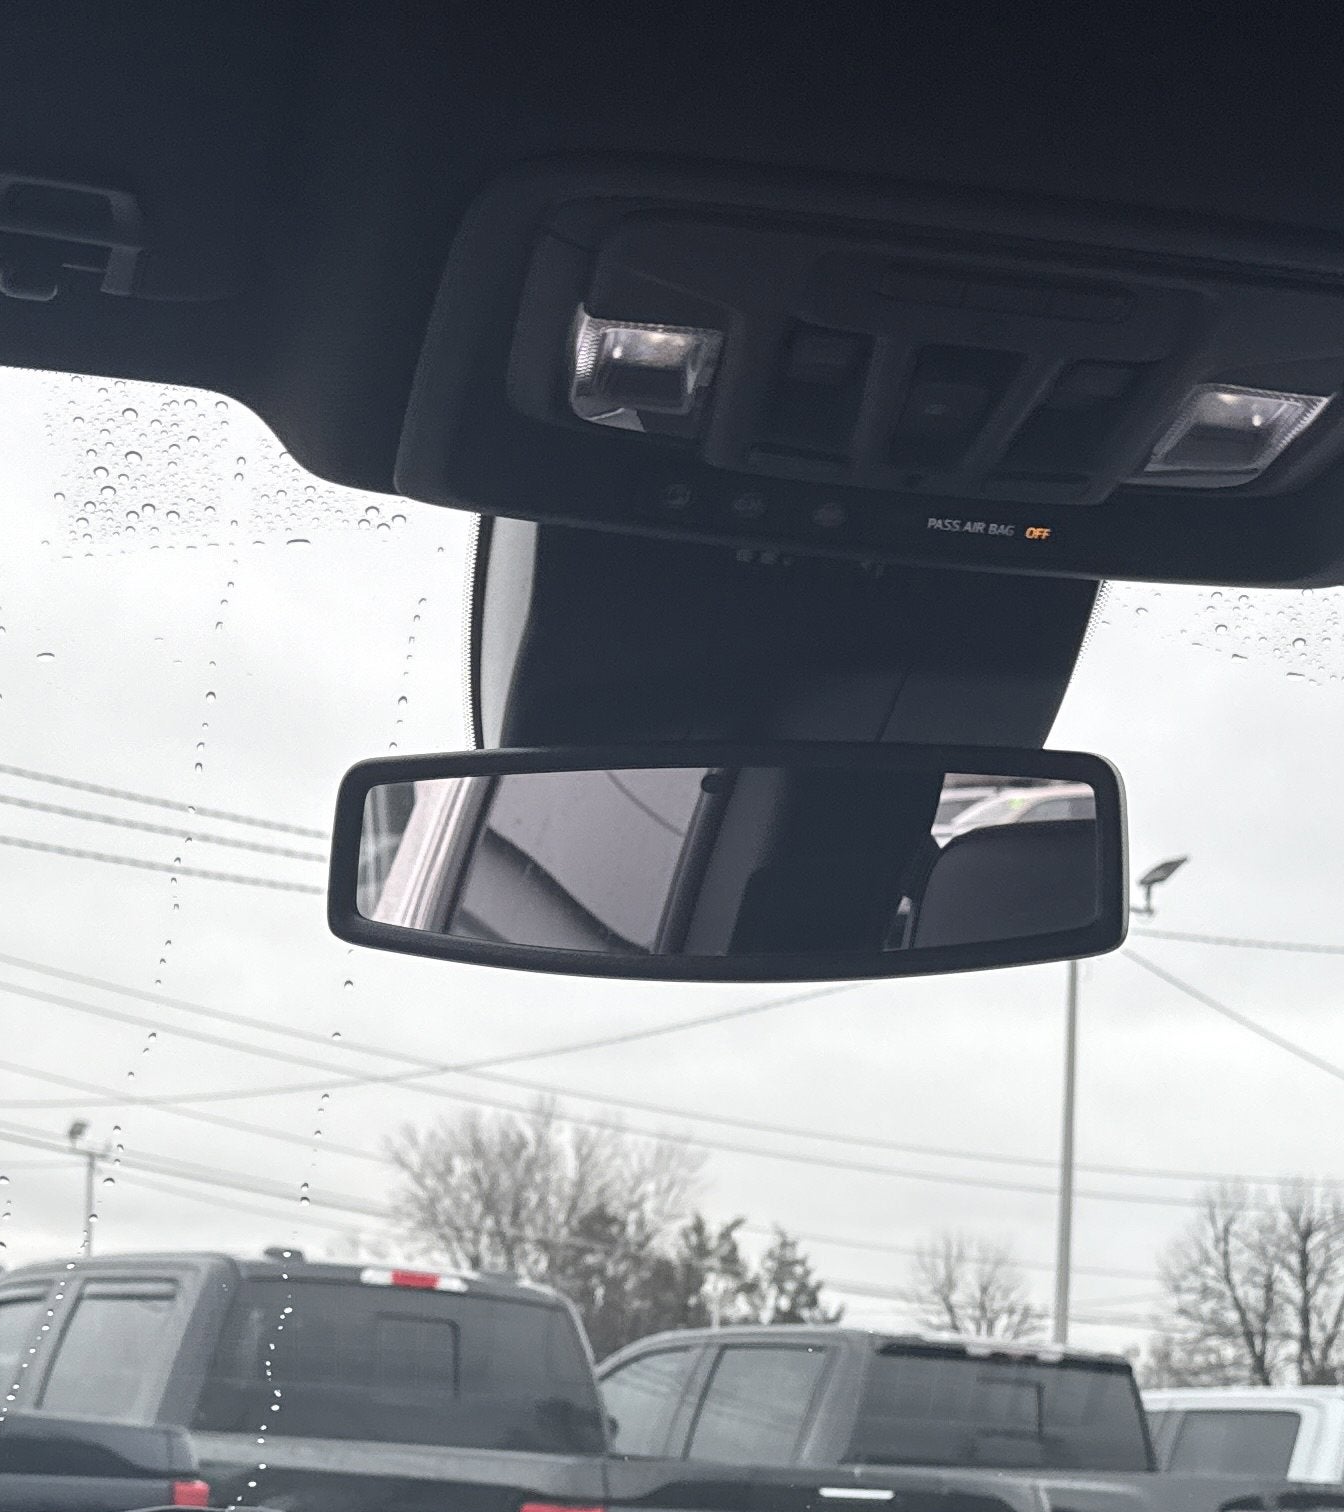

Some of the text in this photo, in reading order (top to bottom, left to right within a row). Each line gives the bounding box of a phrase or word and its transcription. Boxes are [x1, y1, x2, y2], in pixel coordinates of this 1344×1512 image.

[927, 518, 1051, 540] PASS AIR BAG OFF
